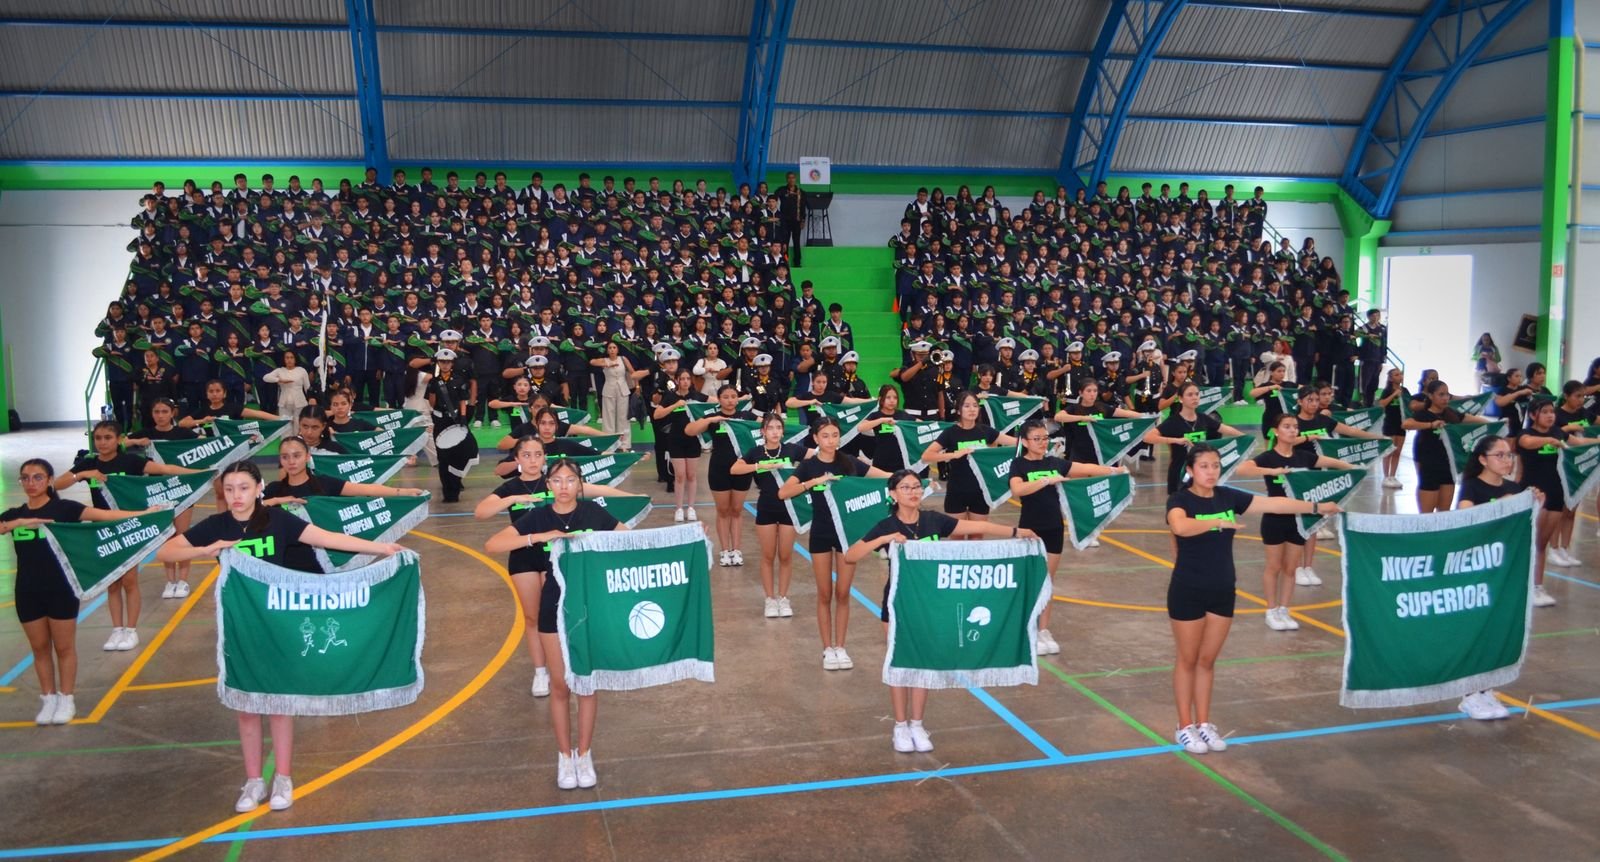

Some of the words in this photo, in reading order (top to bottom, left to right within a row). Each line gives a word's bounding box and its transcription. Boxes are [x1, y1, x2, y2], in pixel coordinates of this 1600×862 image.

[177, 434, 235, 467] TEZONTLA
[844, 490, 882, 513] PONCIANO
[1302, 473, 1353, 503] PROGRESO
[338, 503, 364, 522] RAFAEL
[366, 497, 386, 512] NIETO
[96, 527, 116, 541] LIC.
[97, 539, 123, 558] SILVA
[121, 524, 160, 548] HERZOG
[342, 516, 375, 536] COMPEAN
[936, 563, 1018, 590] BEISBOL
[1380, 554, 1434, 582] NIVEL
[1442, 541, 1505, 575] MEDIO
[605, 560, 690, 594] BASQUETBOL
[266, 580, 371, 611] ATLETISMO
[1395, 582, 1490, 619] SUPERIOR
